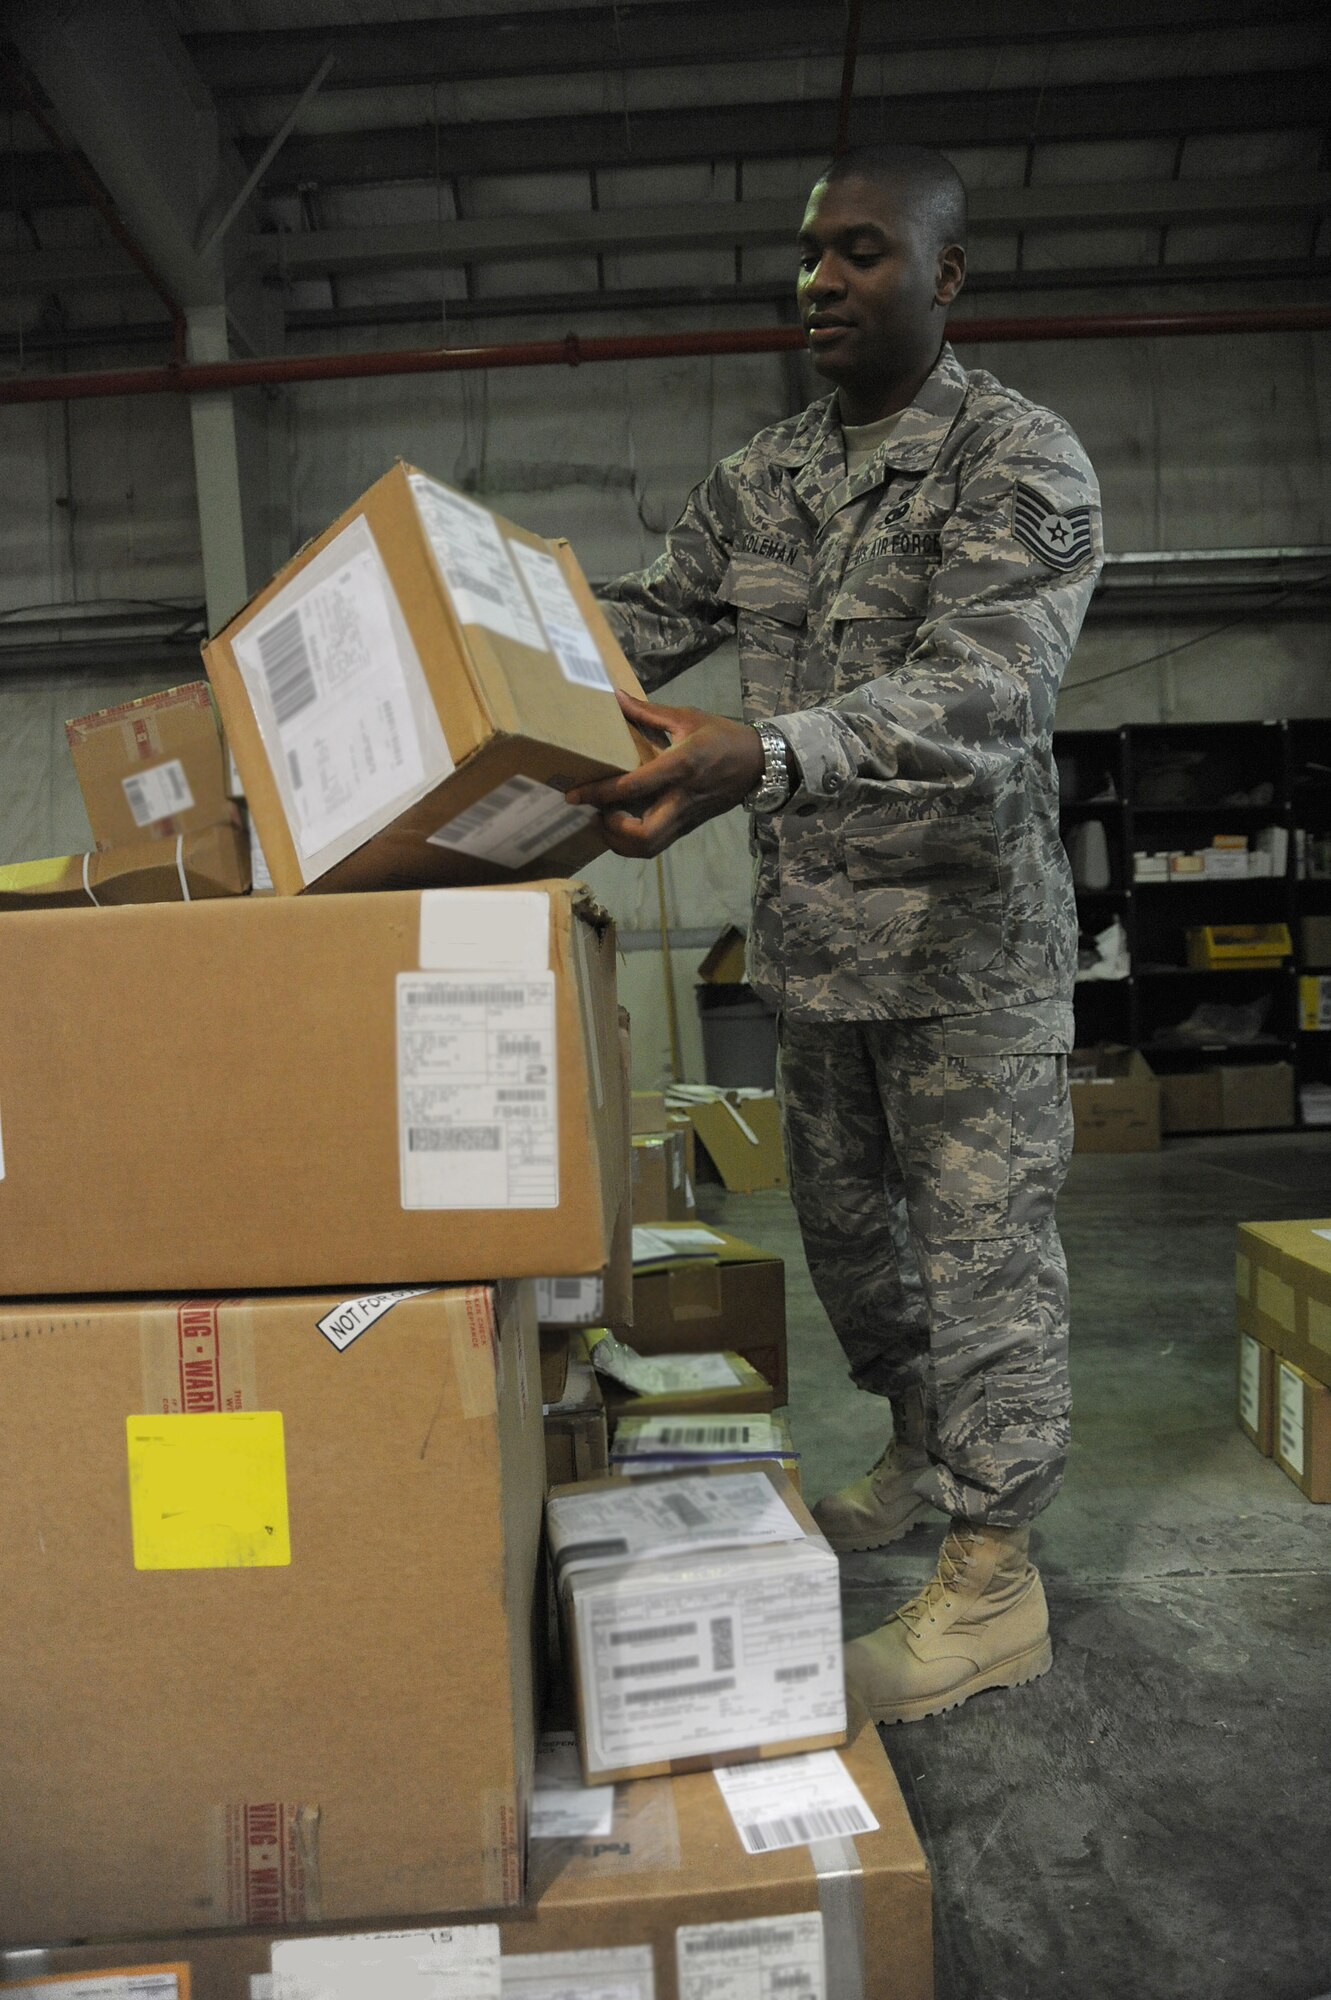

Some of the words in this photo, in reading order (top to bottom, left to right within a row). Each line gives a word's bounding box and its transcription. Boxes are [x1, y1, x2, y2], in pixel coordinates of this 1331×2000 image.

[743, 534, 799, 566] COLEMAN
[869, 537, 889, 558] AIR
[892, 533, 941, 554] FORCE
[525, 1064, 547, 1084] 2
[329, 1307, 361, 1341] NOT
[357, 1295, 391, 1316] FOR
